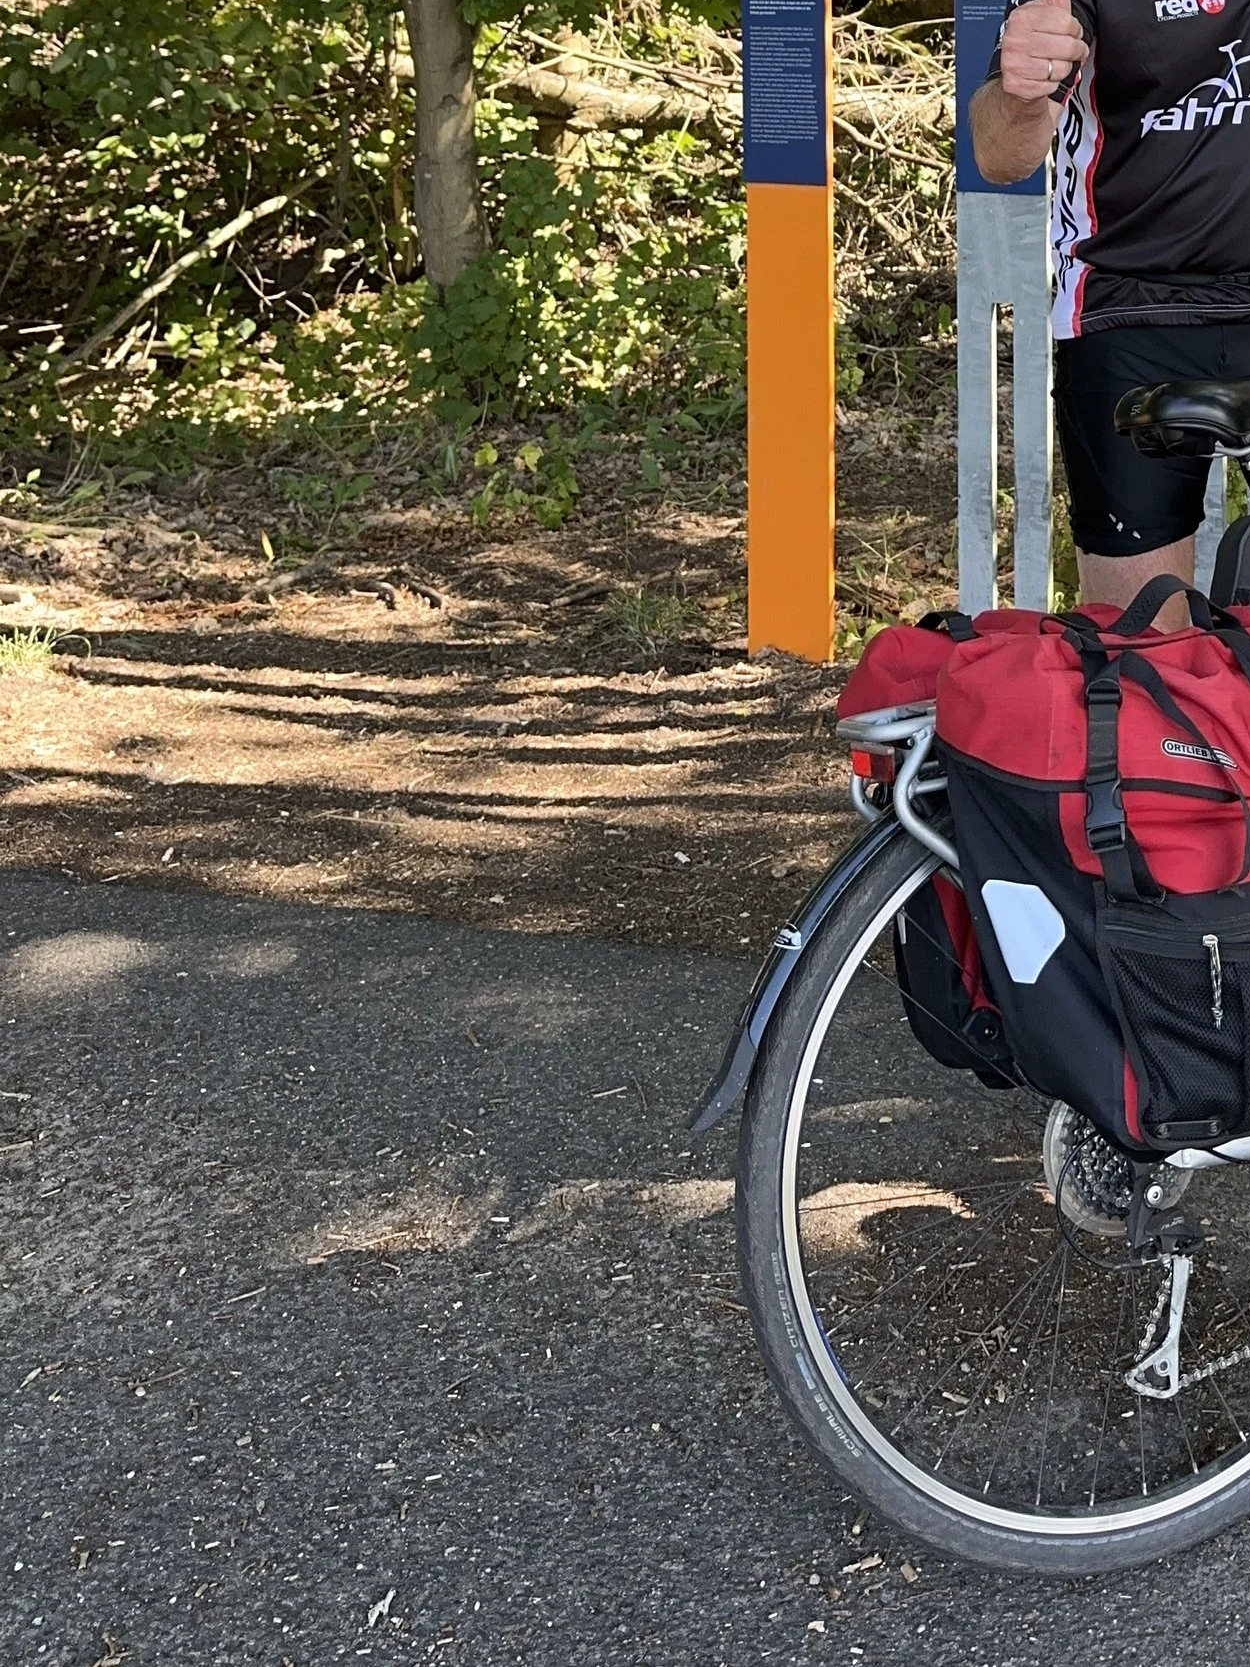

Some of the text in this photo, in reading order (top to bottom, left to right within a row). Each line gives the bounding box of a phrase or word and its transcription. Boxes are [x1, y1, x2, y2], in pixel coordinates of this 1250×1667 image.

[1166, 742, 1208, 758] ORTLIEB
[777, 1289, 863, 1459] SCHWALBE CITIZEN
